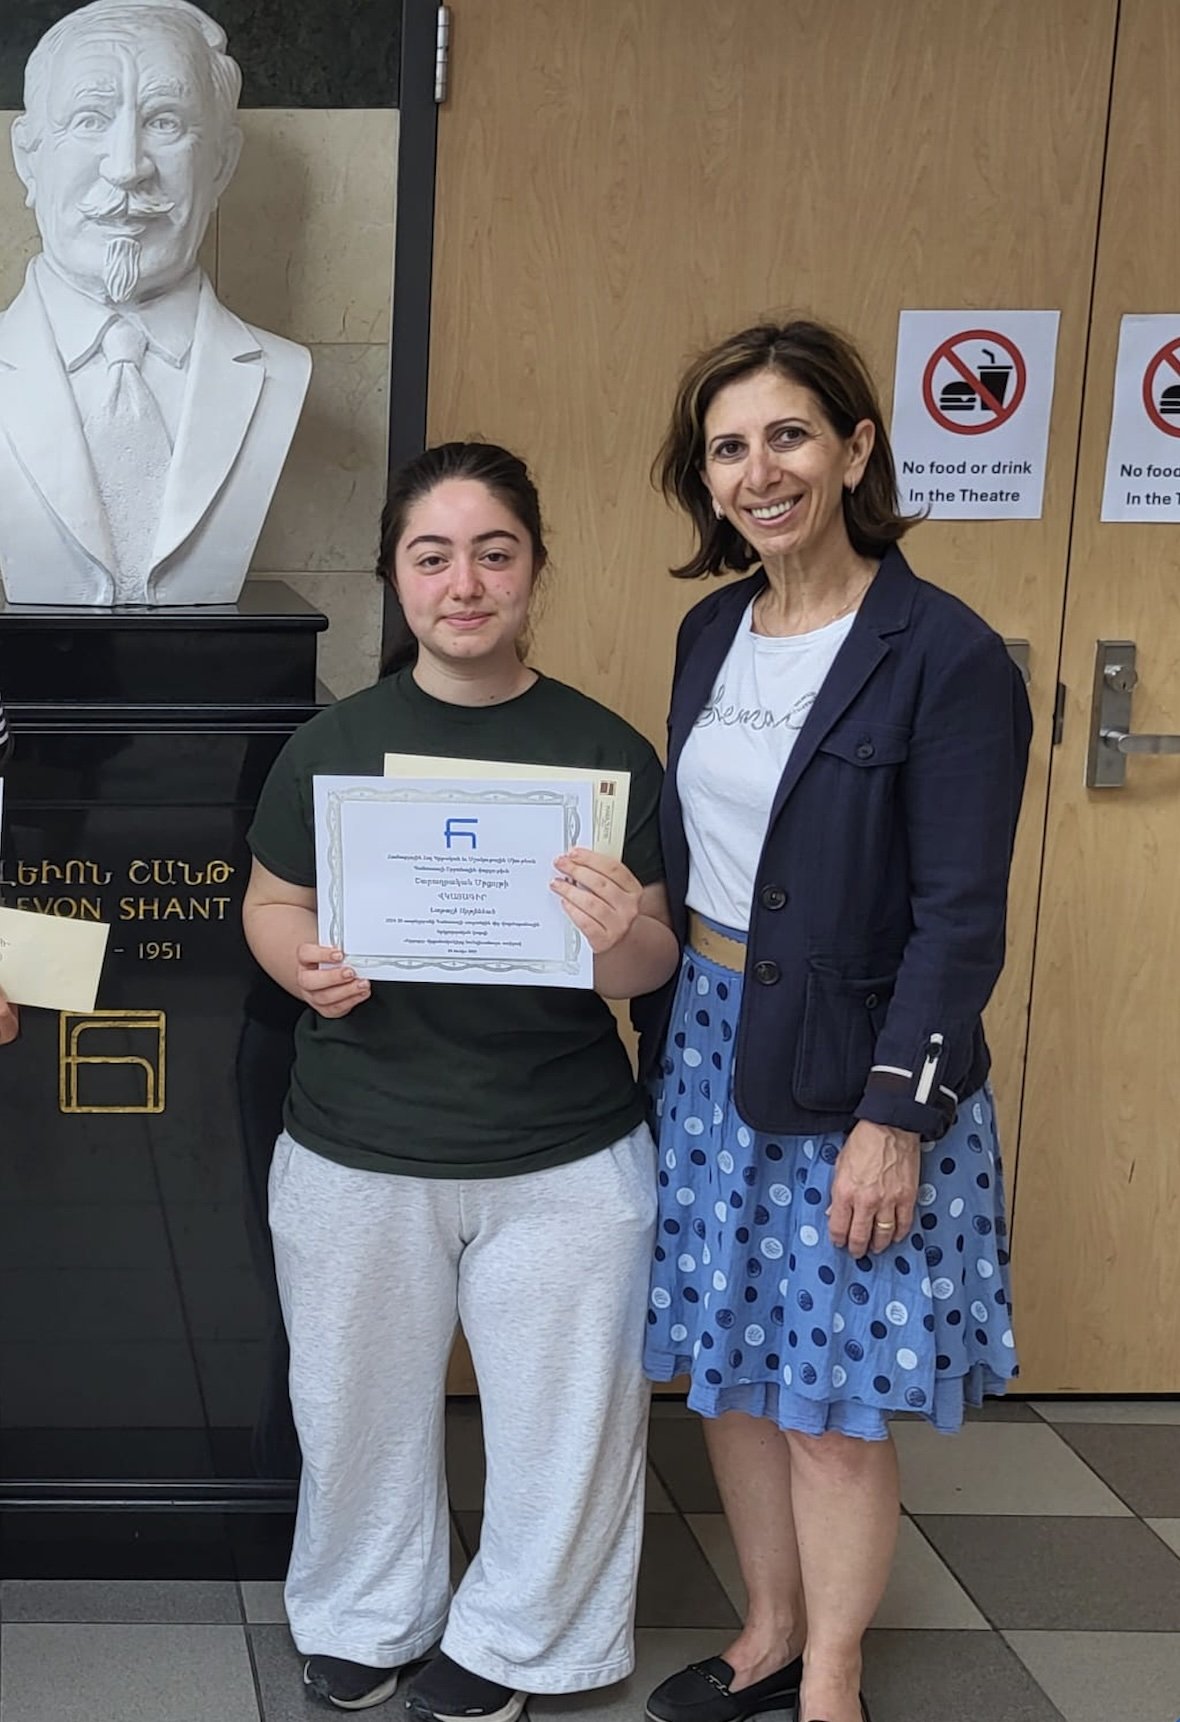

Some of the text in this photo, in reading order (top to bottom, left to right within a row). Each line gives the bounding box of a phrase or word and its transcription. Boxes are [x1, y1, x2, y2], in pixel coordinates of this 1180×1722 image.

[902, 461, 1032, 474] No food or drink
[1120, 464, 1143, 478] No
[909, 488, 1020, 502] In the Theatre
[1126, 491, 1141, 505] In
[1145, 491, 1172, 505] the
[128, 860, 235, 886] ՇԱՆԹ
[119, 897, 231, 921] SHANT
[138, 942, 183, 960] 1951
